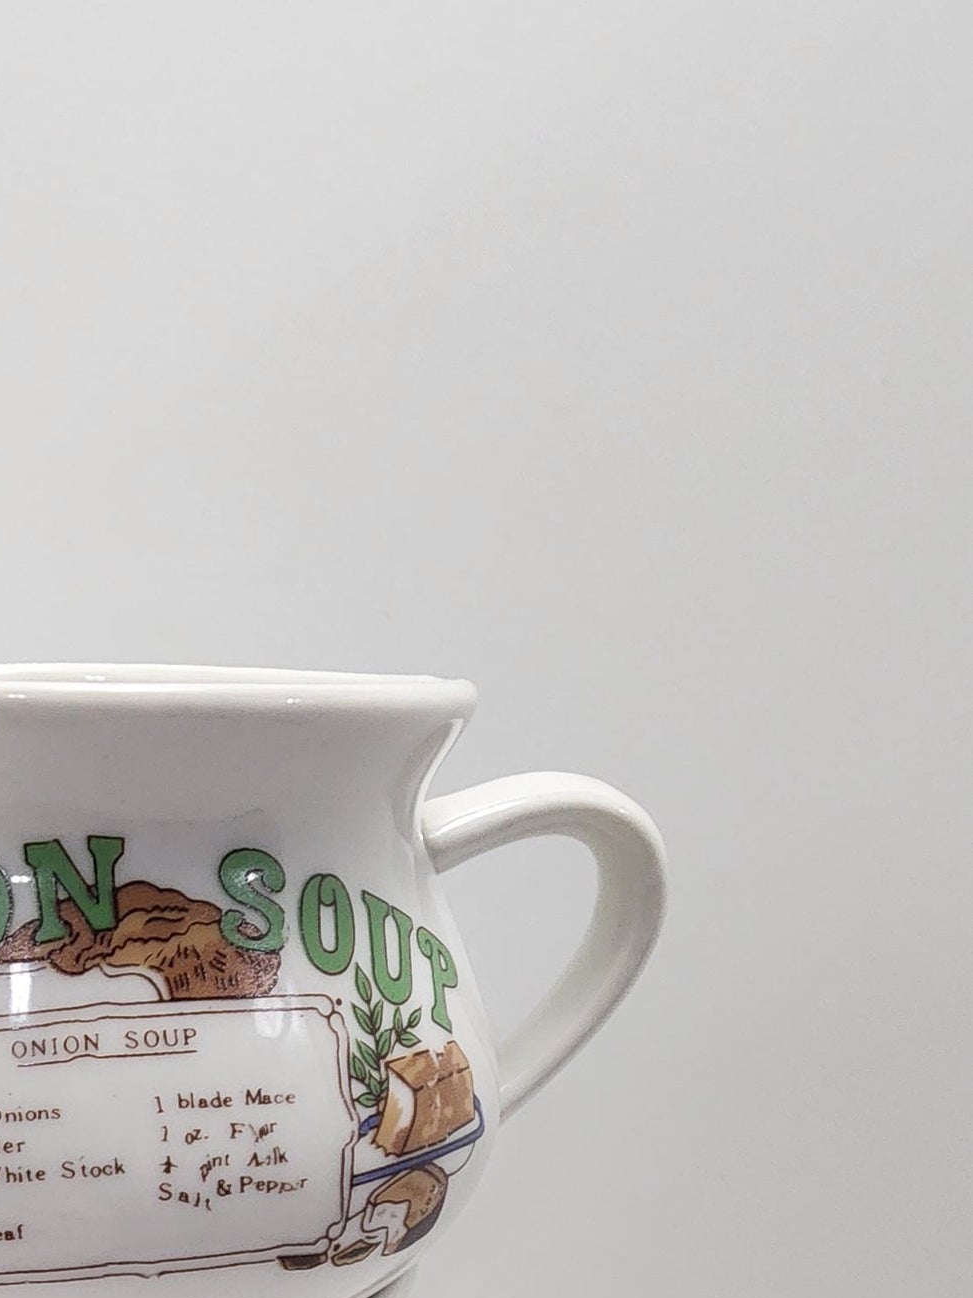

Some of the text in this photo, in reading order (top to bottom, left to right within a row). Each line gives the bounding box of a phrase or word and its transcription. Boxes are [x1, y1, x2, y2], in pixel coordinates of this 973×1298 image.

[218, 847, 458, 1034] SOUP
[11, 1027, 198, 1059] ONION SOUP
[154, 1088, 297, 1114] 1 blade Mace
[161, 1125, 169, 1143] 1
[60, 1155, 127, 1180] Stock
[158, 1182, 212, 1212] Salt
[215, 1178, 233, 1198] &
